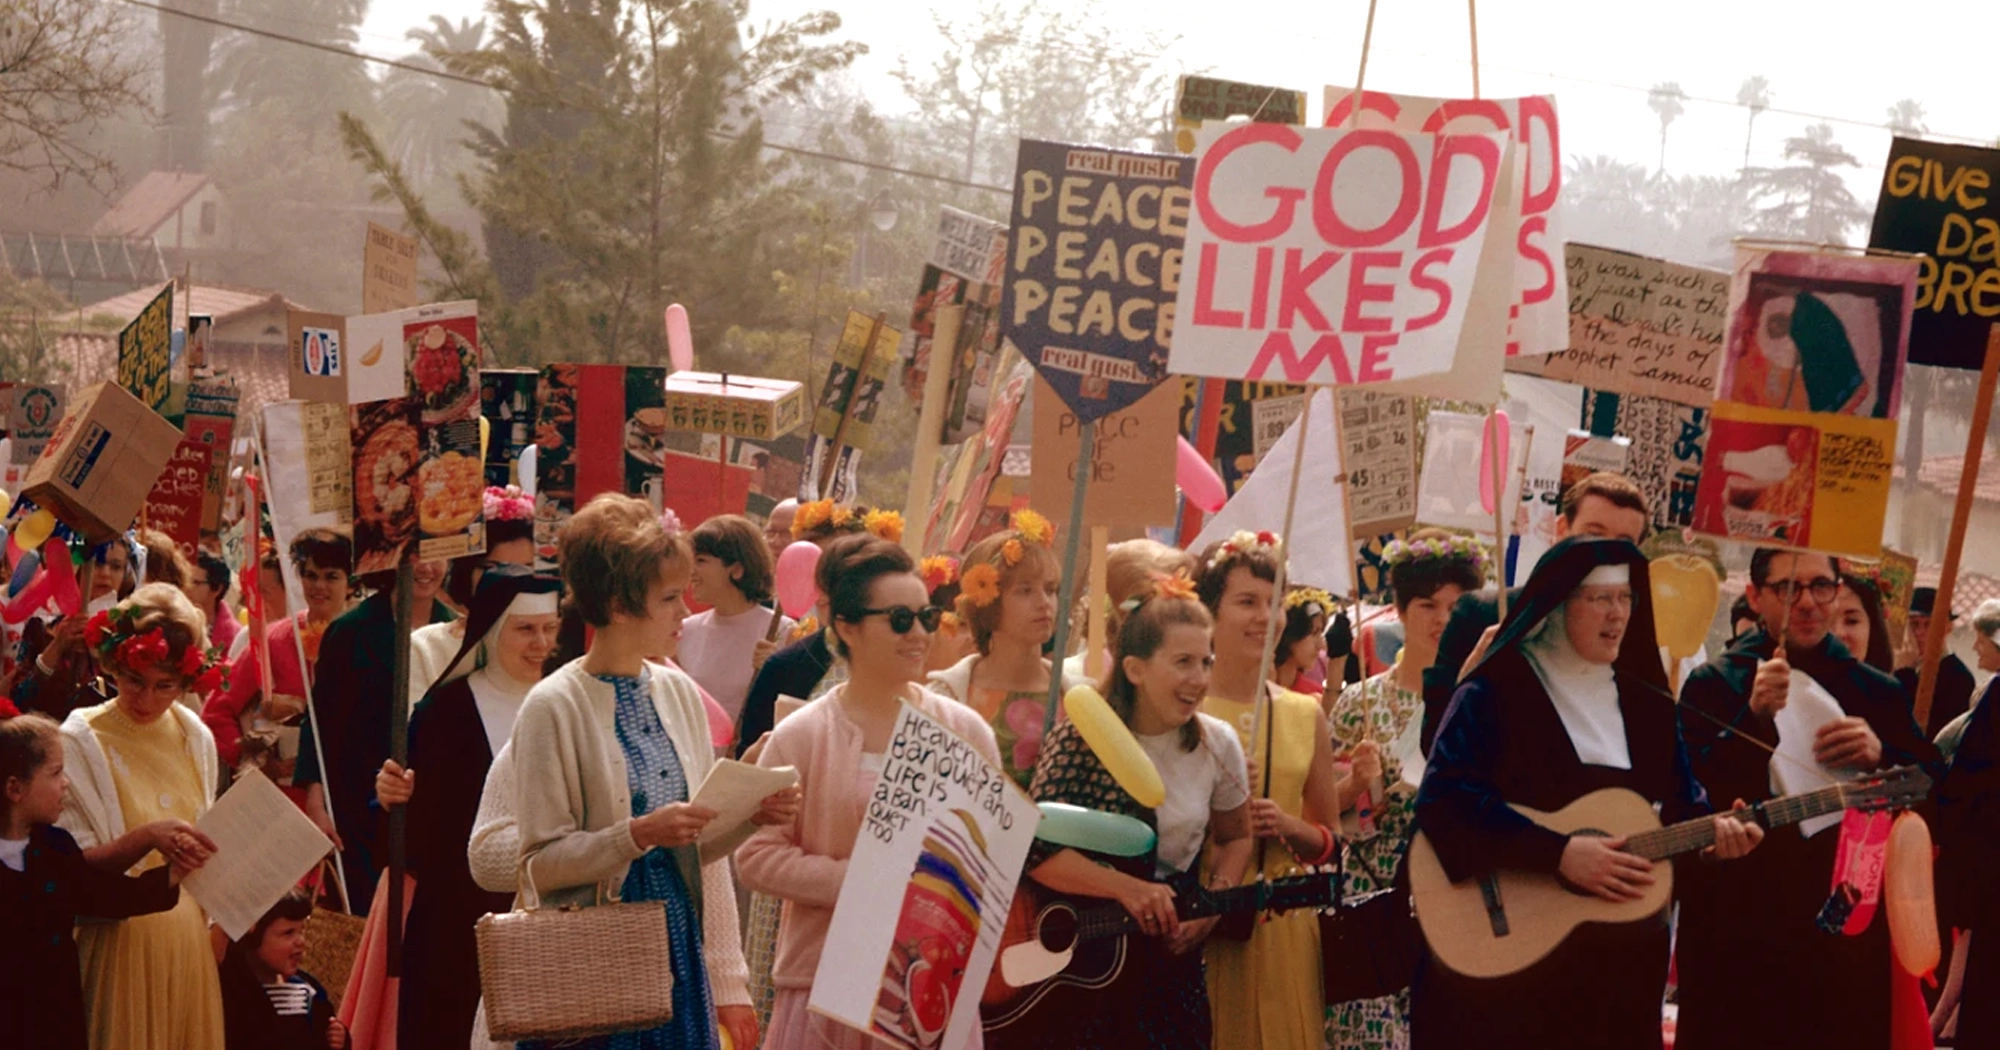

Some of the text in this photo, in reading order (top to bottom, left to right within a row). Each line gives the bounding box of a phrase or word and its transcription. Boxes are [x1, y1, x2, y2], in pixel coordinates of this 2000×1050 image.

[1066, 150, 1181, 179] real gusto
[1193, 121, 1502, 249] GOD
[1022, 169, 1193, 238] PEACE
[1014, 226, 1185, 293] PEACE
[1652, 270, 1704, 291] such
[1013, 279, 1177, 349] PEACE
[1192, 242, 1456, 333] LIKES
[1043, 348, 1088, 370] real
[1244, 331, 1400, 385] ME
[1629, 355, 1715, 391] Samue
[1350, 467, 1369, 488] 45
